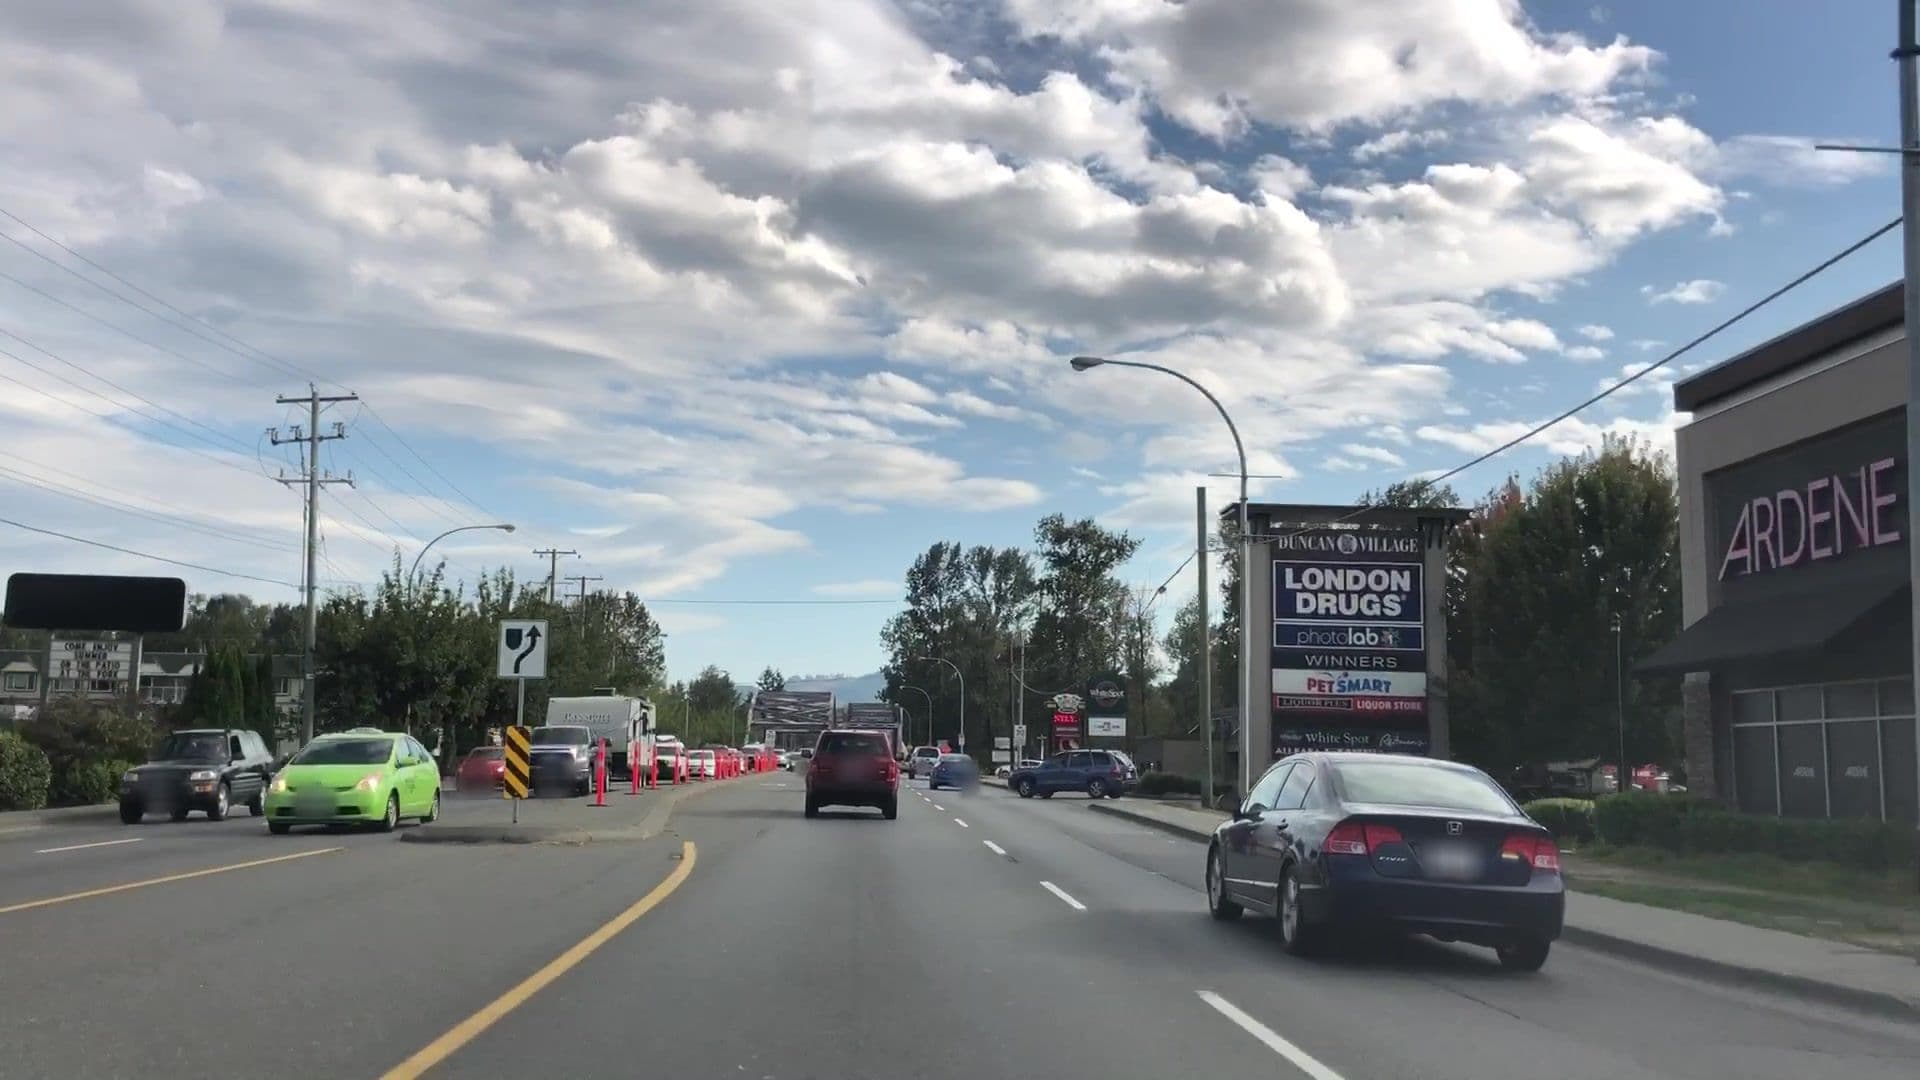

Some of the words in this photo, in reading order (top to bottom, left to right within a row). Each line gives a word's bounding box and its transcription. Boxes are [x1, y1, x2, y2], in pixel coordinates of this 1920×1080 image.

[1718, 457, 1900, 581] ARDENE
[1278, 536, 1335, 551] DUNCAN
[1358, 537, 1419, 552] VILLAGE
[1285, 567, 1411, 592] LONDON
[1297, 627, 1379, 646] photolab
[1304, 655, 1398, 668] WINNERS
[1356, 700, 1392, 711] LIQUOR
[1393, 701, 1422, 711] STORE
[1305, 731, 1340, 744] White
[1343, 732, 1370, 746] Spot
